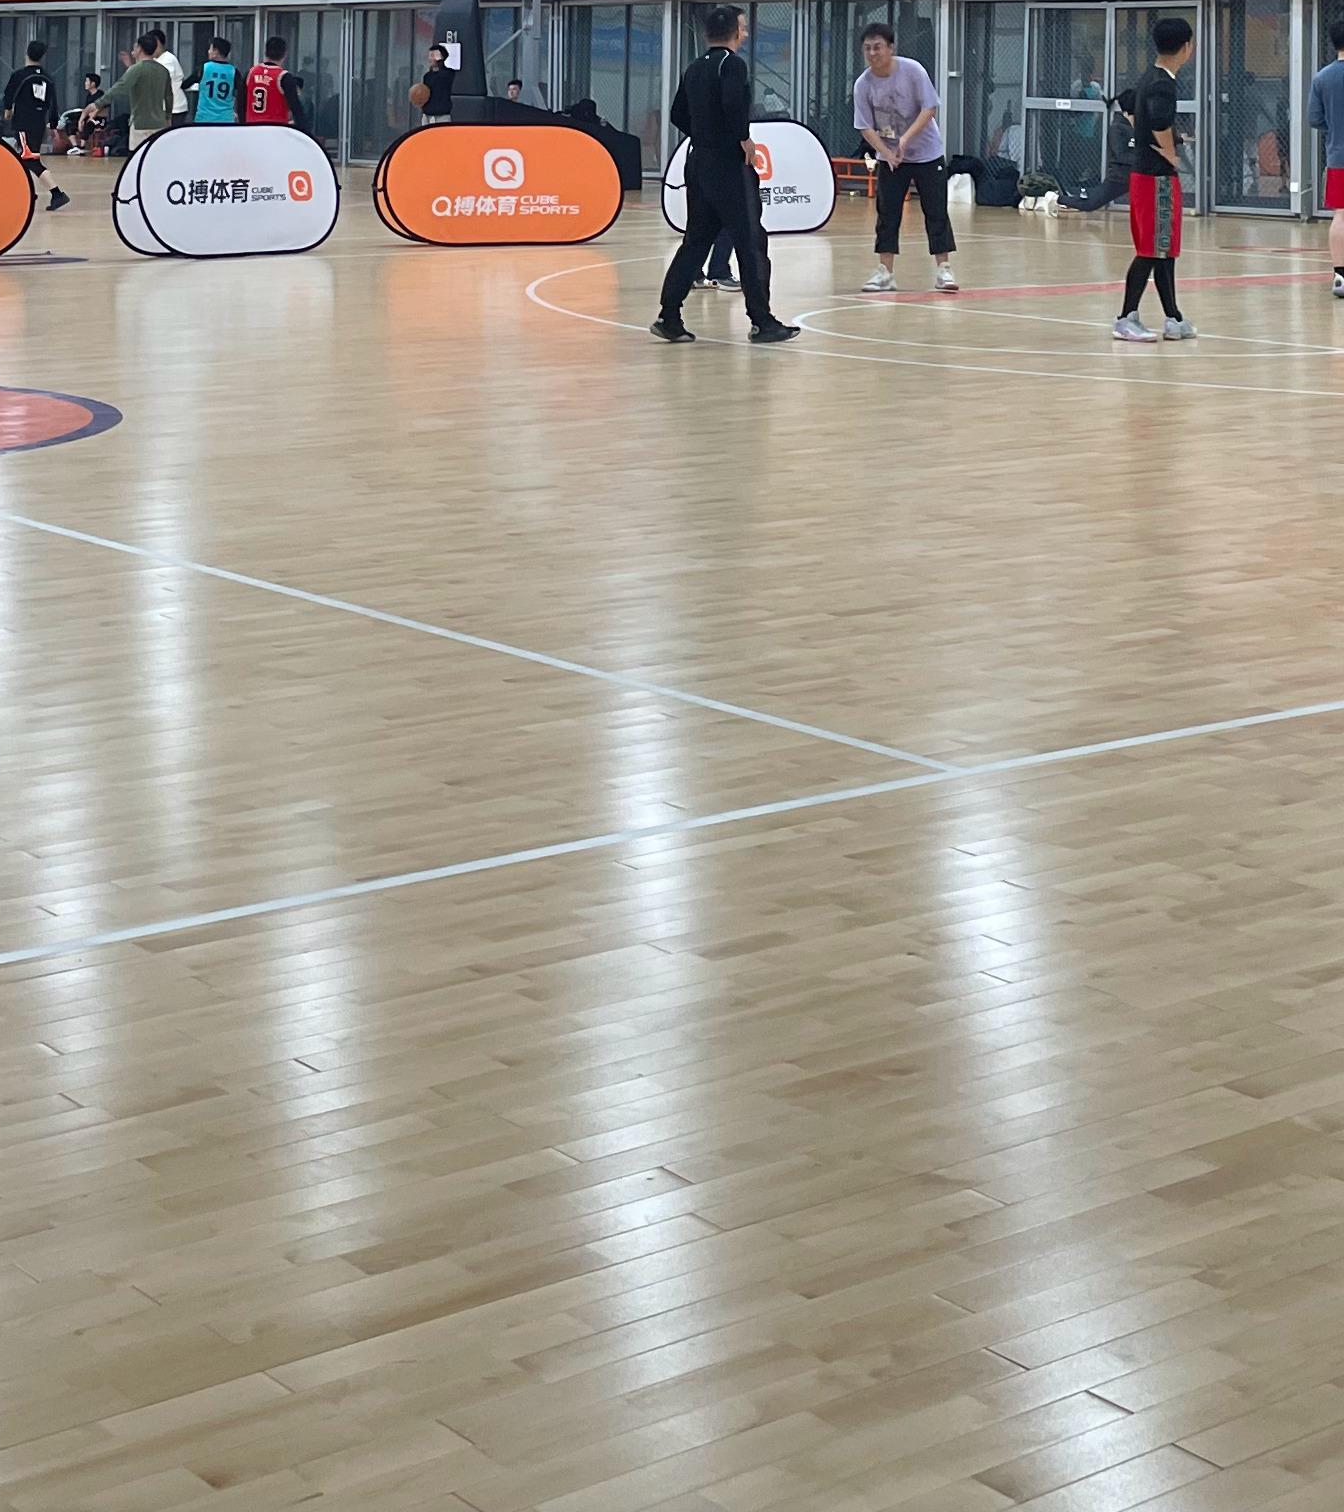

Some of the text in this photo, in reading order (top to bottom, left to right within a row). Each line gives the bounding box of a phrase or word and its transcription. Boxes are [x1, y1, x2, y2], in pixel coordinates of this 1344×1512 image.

[206, 80, 230, 100] 19
[252, 87, 267, 113] 3
[251, 186, 274, 194] CUBE
[773, 186, 797, 195] CUBE
[251, 193, 286, 202] SPORTS
[520, 195, 559, 205] CUBE
[773, 194, 811, 204] SPORTS
[519, 205, 580, 215] SPORTS
